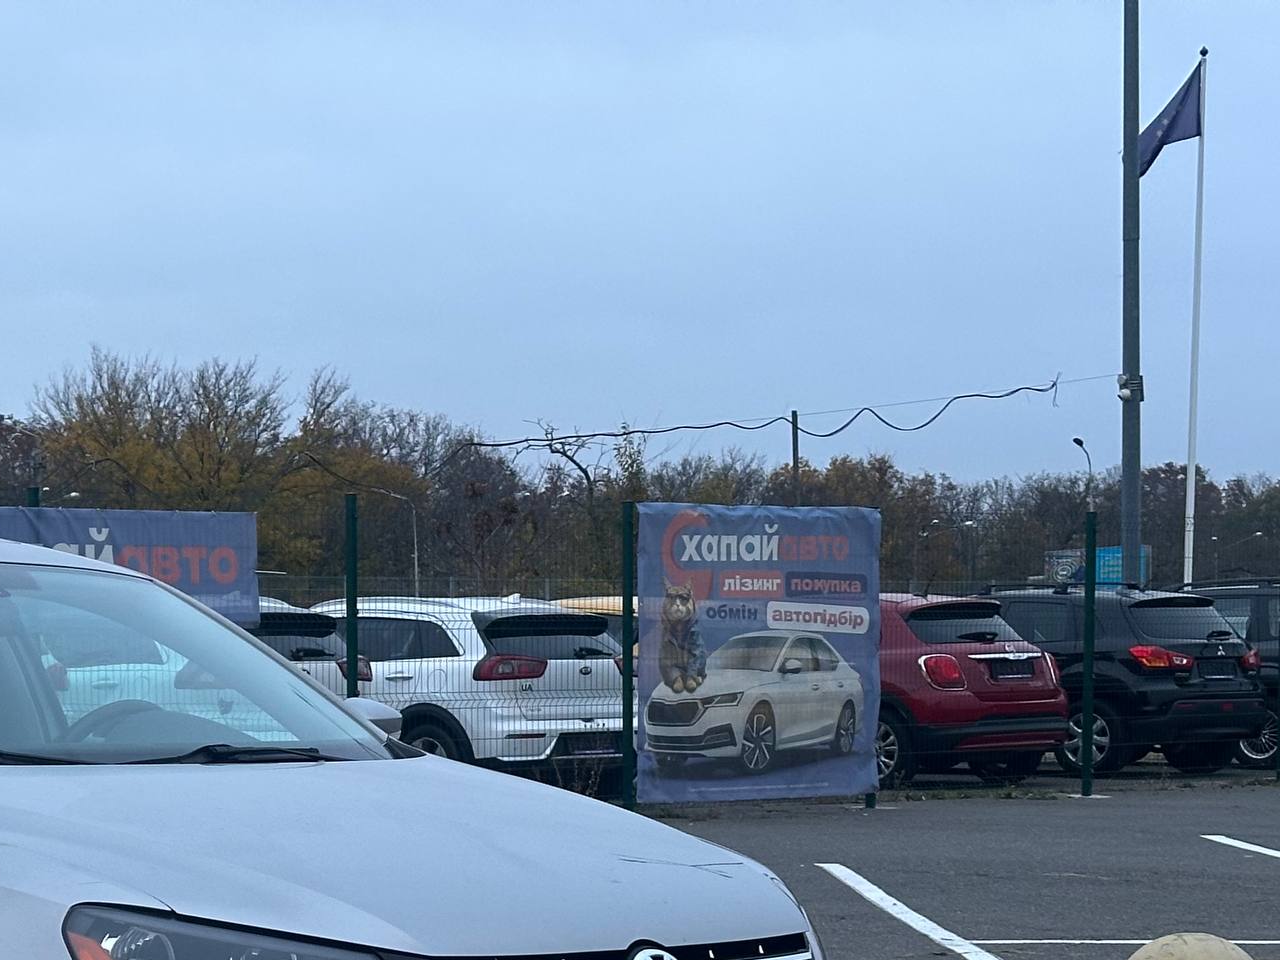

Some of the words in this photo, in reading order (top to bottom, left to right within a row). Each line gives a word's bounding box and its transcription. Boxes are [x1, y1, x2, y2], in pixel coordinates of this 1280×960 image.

[723, 575, 782, 592] лізинг
[790, 578, 862, 594] покупка
[706, 604, 758, 621] обмін
[771, 608, 864, 629] автопідбір
